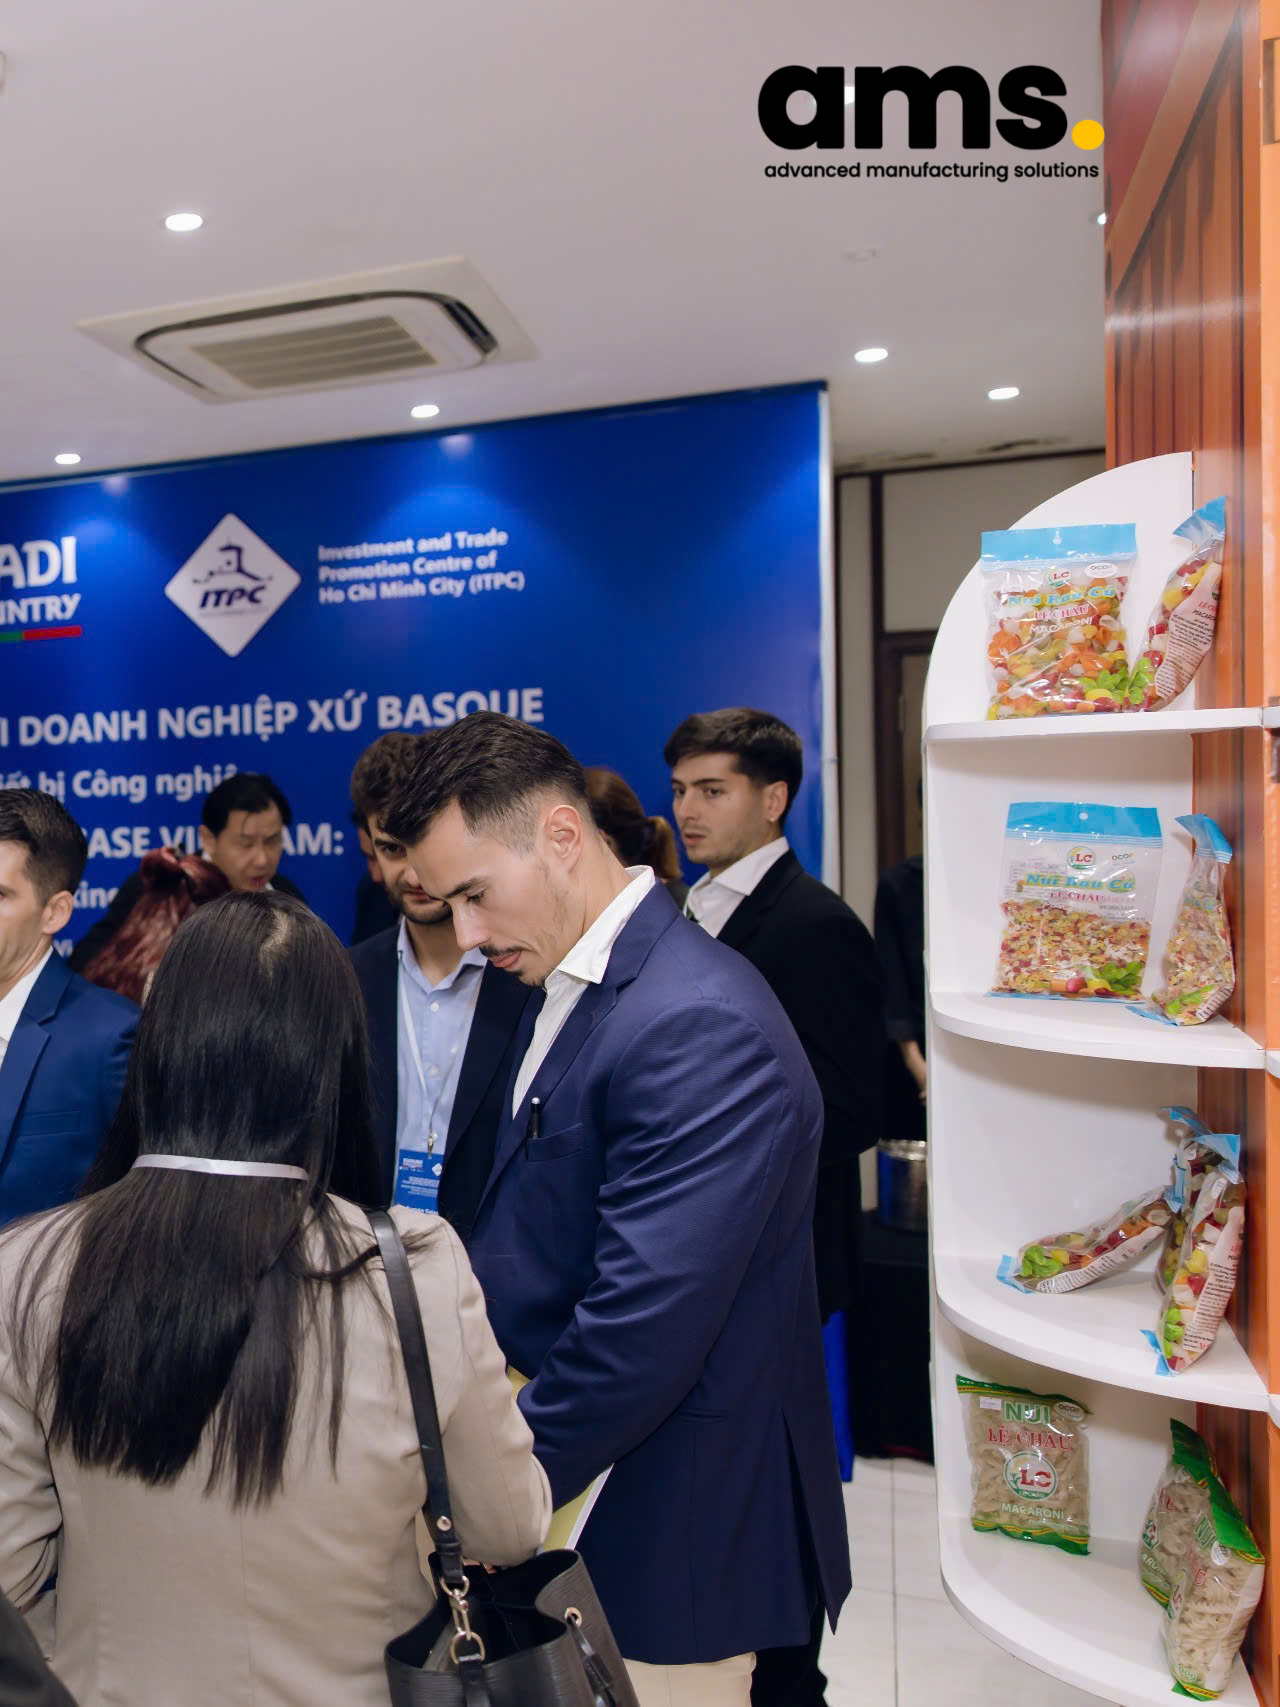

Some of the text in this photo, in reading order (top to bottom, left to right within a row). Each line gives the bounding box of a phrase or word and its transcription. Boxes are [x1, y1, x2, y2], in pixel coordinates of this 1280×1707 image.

[318, 527, 509, 562] Investment and Trade
[318, 549, 498, 583] Promotion Centre of
[200, 584, 267, 609] ITPC
[318, 570, 526, 604] Ho Chi Minh City (ITPC)
[19, 710, 147, 747] DOANH
[158, 694, 298, 742] NGHIỆP
[308, 691, 368, 733] XỨ
[377, 687, 545, 730] BASQUE
[72, 767, 148, 804] Công
[155, 762, 238, 802] nghi
[87, 825, 151, 859] ASE
[1075, 853, 1093, 863] LC
[1004, 1402, 1051, 1425] NUI
[1019, 1469, 1052, 1488] LC
[1001, 1502, 1065, 1520] MACARONI
